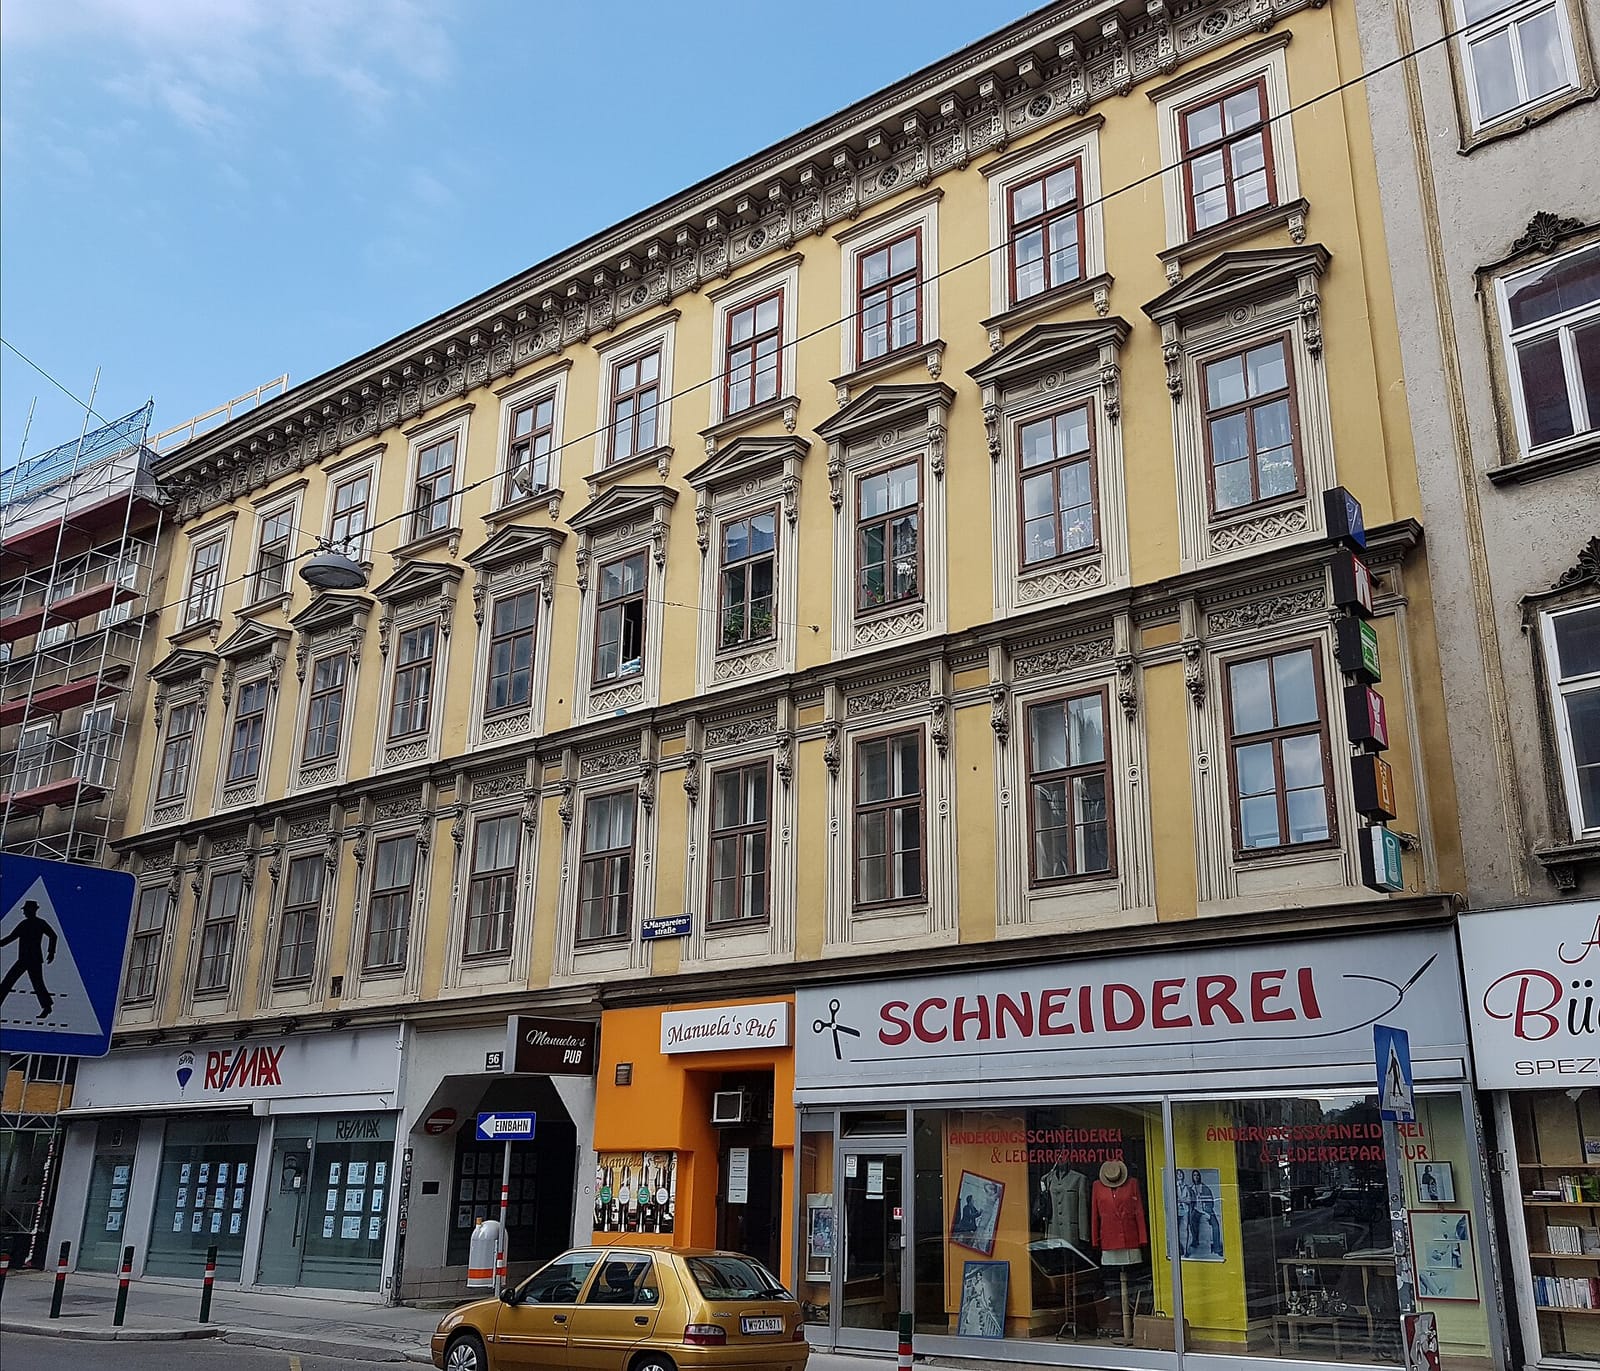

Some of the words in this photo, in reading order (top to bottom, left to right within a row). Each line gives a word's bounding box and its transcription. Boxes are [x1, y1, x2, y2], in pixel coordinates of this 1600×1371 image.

[654, 926, 677, 936] straße
[878, 966, 1323, 1046] SCHNEIDEREI
[1483, 968, 1600, 1042] Bü
[668, 1014, 743, 1046] Manuela's
[745, 1018, 778, 1039] Pub
[488, 1053, 500, 1065] 56
[562, 1049, 583, 1065] PUB
[203, 1045, 286, 1093] RE/MAX
[335, 1118, 382, 1141] RE/MAX
[494, 1120, 529, 1132] EINBAHN
[1206, 1121, 1425, 1142] ÄNDERUNGSSCHNEIDREI
[991, 1146, 1002, 1164] &
[1005, 1148, 1124, 1164] LEDERREPARATUR
[1277, 1144, 1429, 1163] LEDERREPARUR
